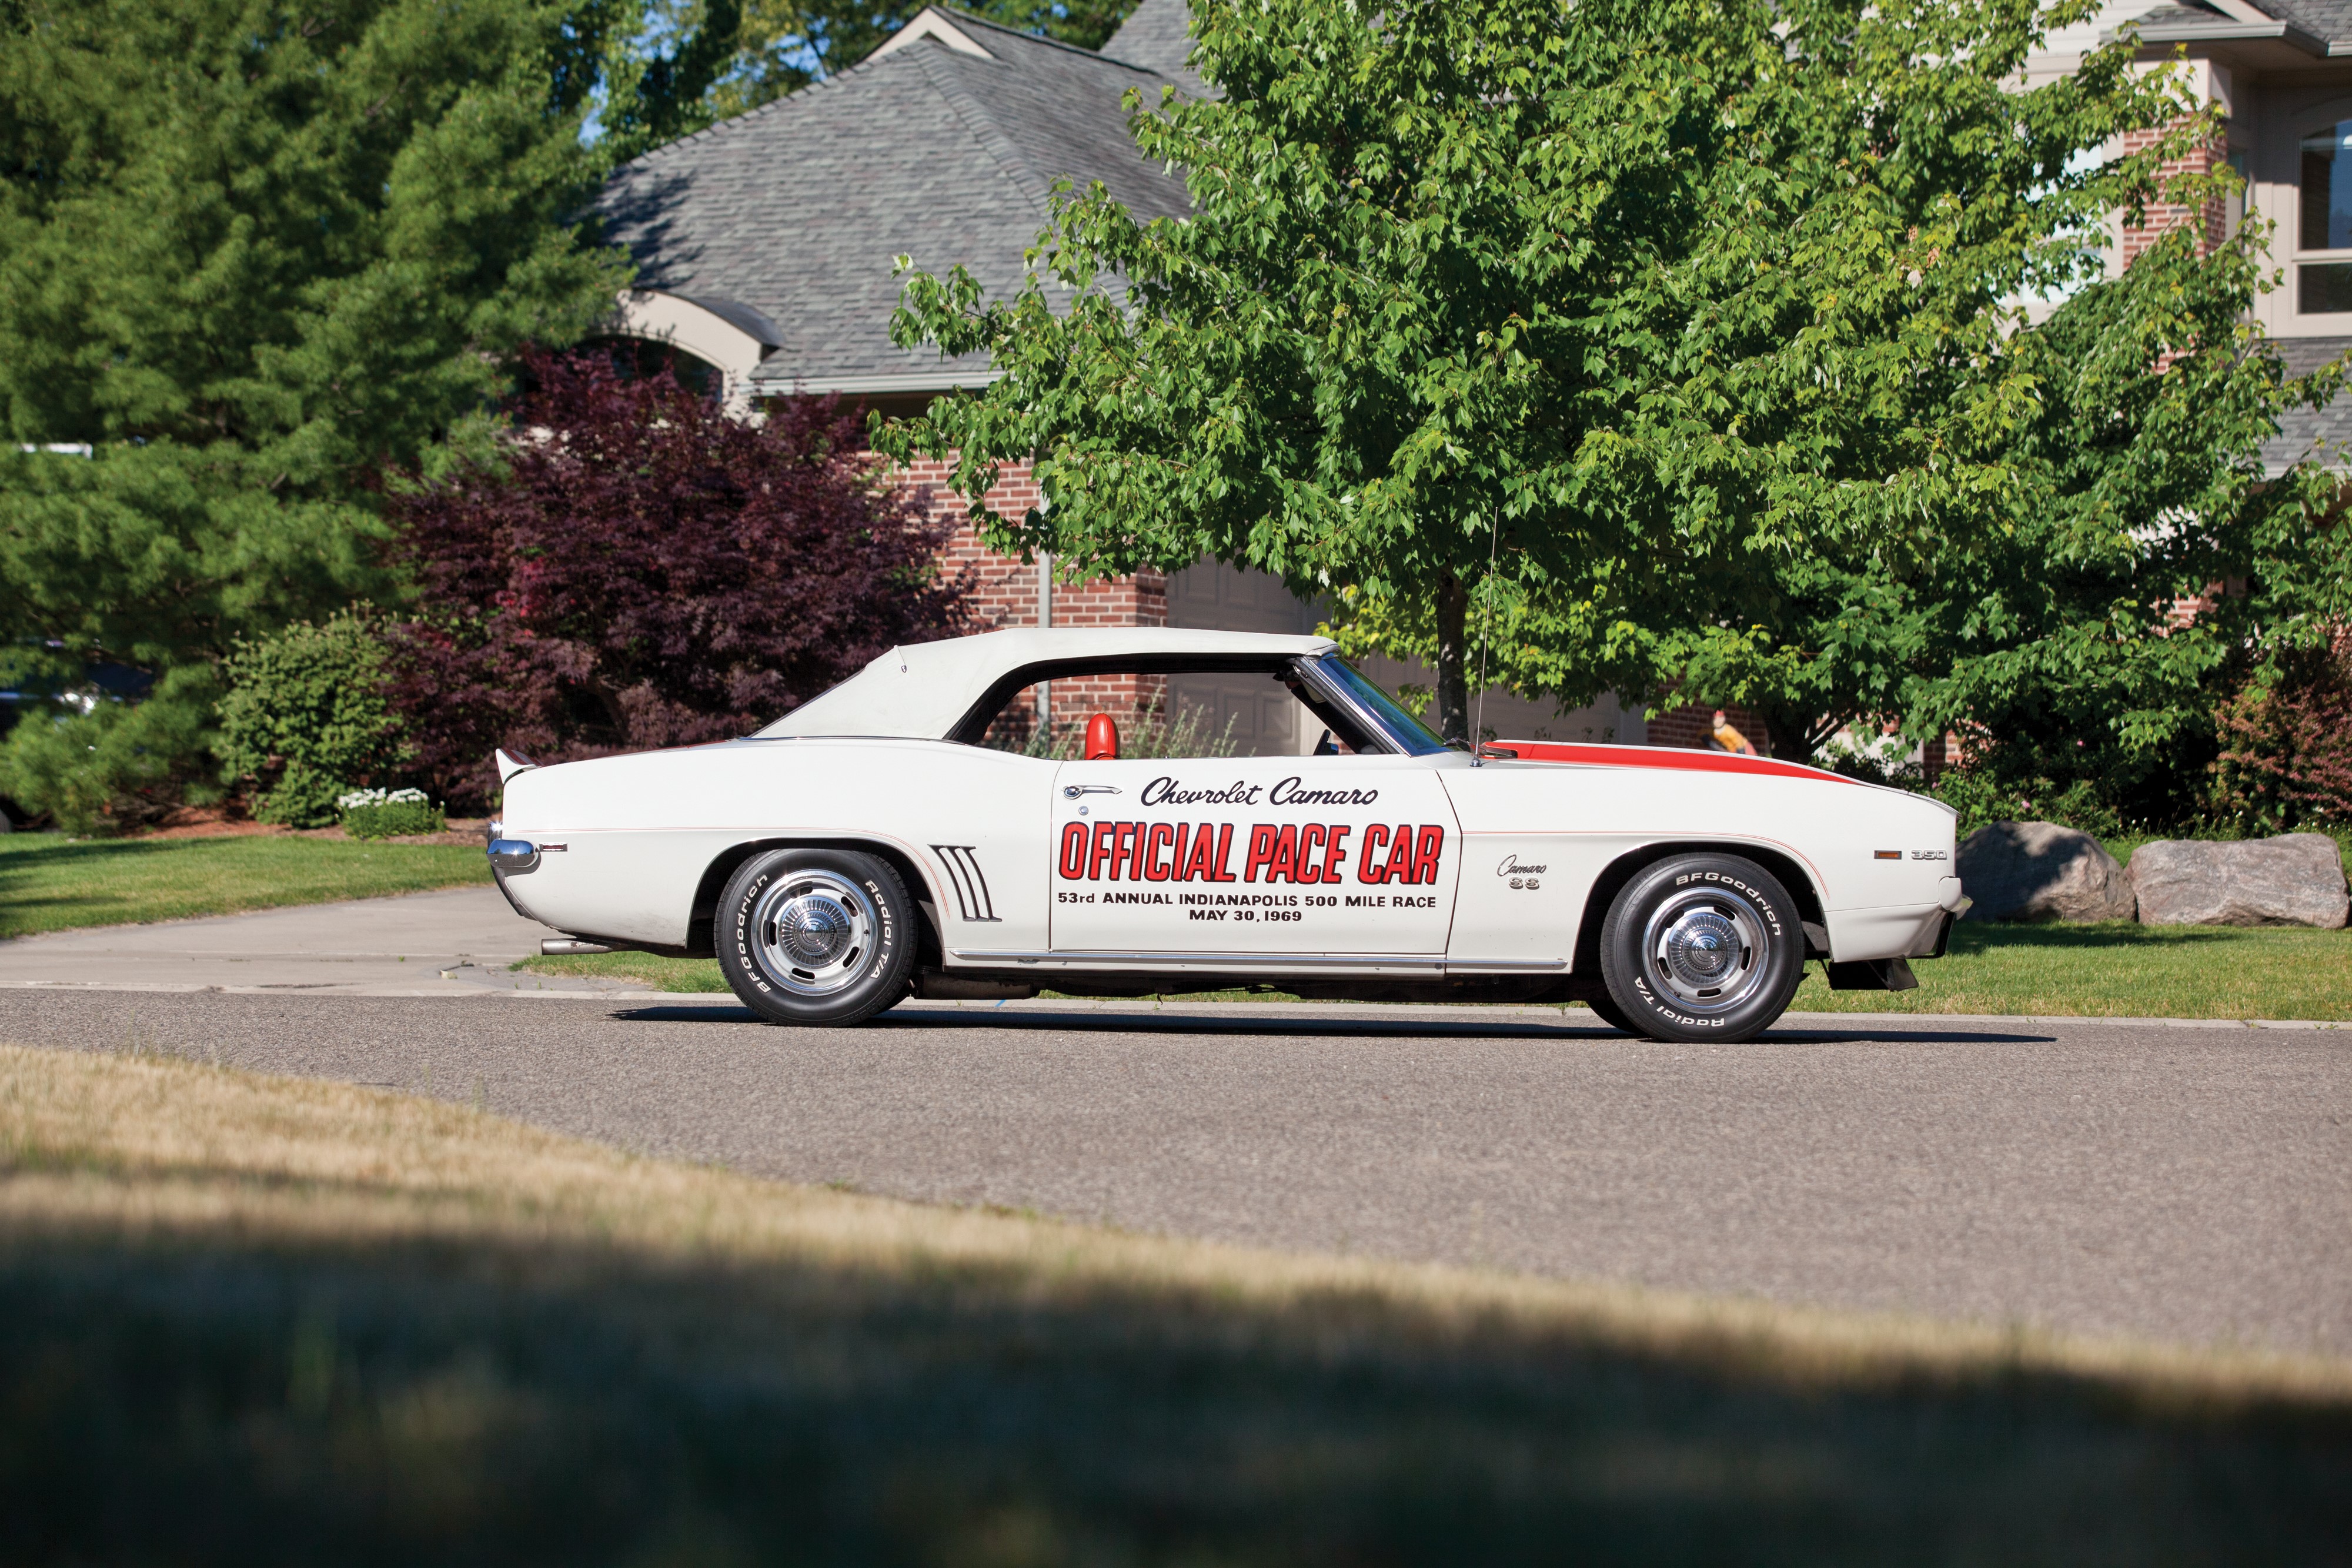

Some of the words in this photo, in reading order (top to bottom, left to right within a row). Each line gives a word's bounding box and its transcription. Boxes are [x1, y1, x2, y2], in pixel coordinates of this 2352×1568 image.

[1141, 777, 1263, 807] Chevrolet
[1269, 776, 1378, 805] Camaro
[1058, 821, 1237, 883] OFFICIAL
[1243, 823, 1351, 885] PACE
[1357, 823, 1445, 885] CAR
[1496, 854, 1547, 877] Camaro
[1911, 850, 1947, 861] 350
[1508, 877, 1540, 890] SS
[865, 880, 892, 946] Radial
[1058, 892, 1095, 904] 53rd
[1102, 892, 1174, 905] ANNUAL
[1178, 894, 1298, 907] INDIANAPOLIS
[1305, 895, 1338, 907] 500
[1345, 895, 1386, 907] MILE
[1392, 896, 1436, 908] RACE
[1676, 872, 1781, 936] BFGoodrich
[1189, 910, 1228, 921] MAY
[1264, 910, 1302, 921] 1969
[737, 874, 771, 994] BFGoodrich
[868, 952, 890, 979] T/A
[1634, 976, 1655, 1006] T/A
[1656, 1005, 1725, 1027] Radial
